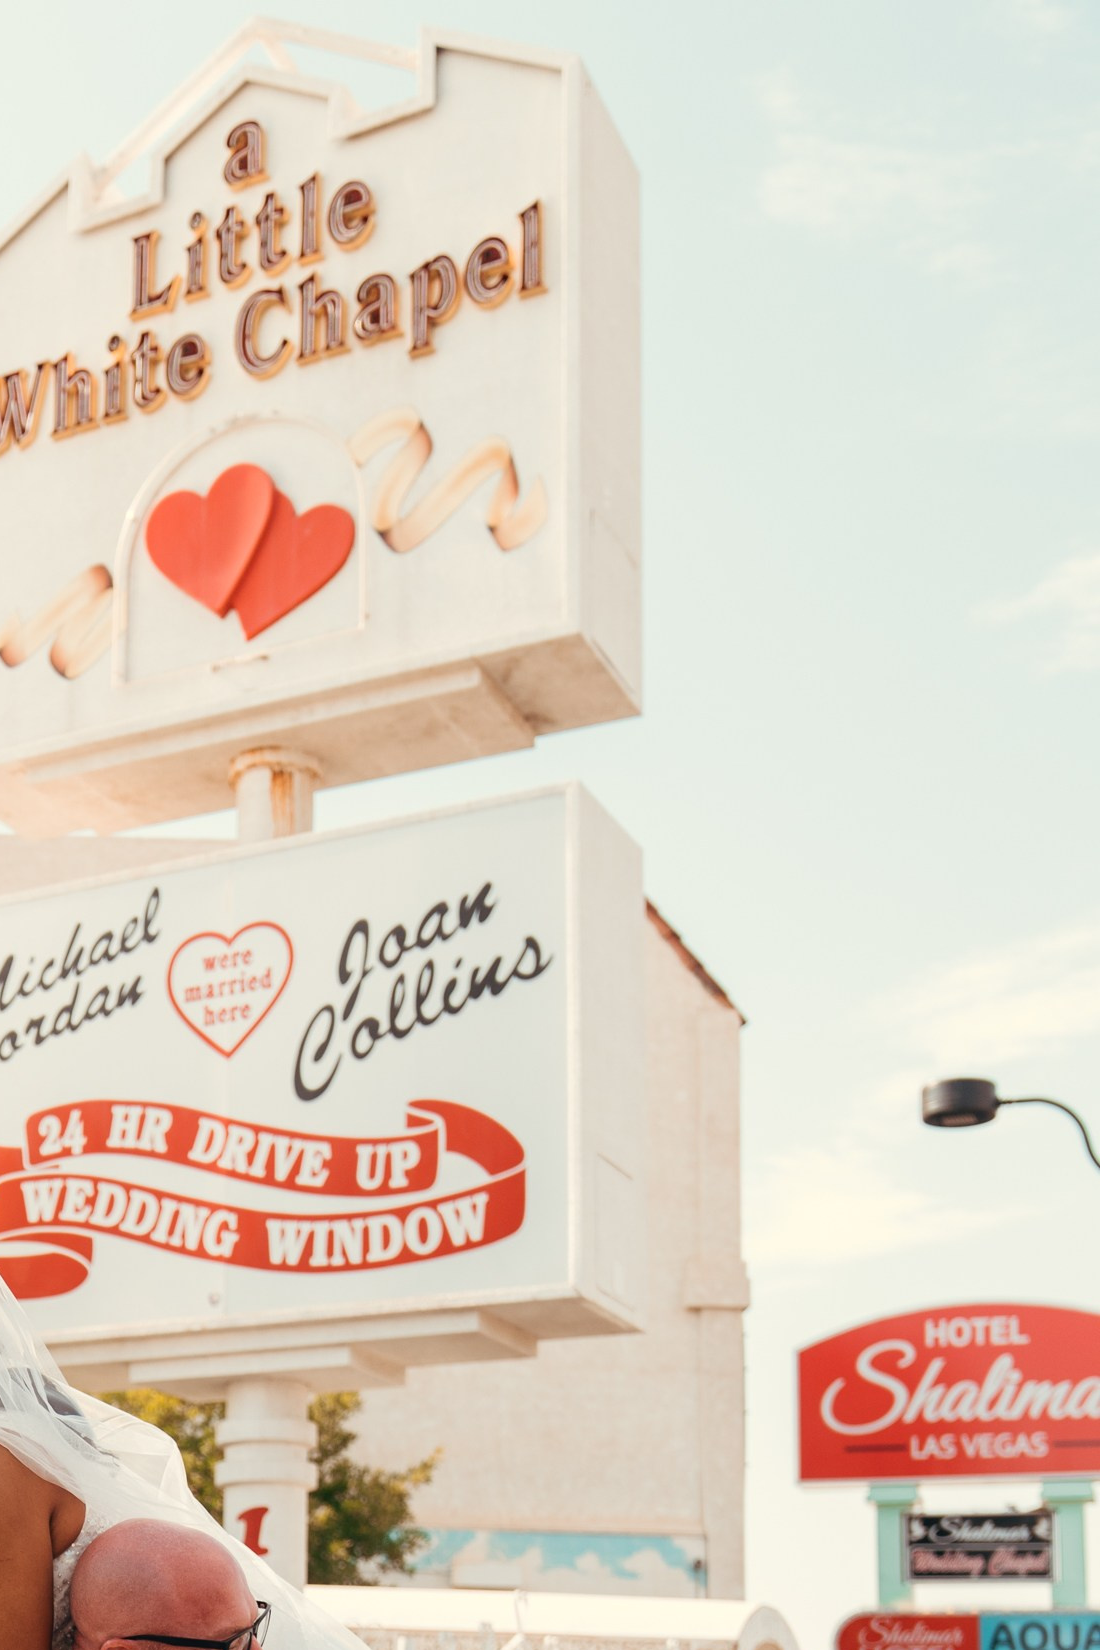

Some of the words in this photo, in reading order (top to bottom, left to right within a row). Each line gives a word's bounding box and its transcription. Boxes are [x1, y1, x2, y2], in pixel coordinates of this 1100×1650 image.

[224, 120, 269, 190] a
[130, 171, 376, 321] Little
[234, 199, 547, 380] Chapel
[185, 966, 272, 1003] married
[203, 949, 252, 972] were
[338, 881, 498, 1022] Joan
[204, 1003, 251, 1027] here
[294, 935, 555, 1102] Collins
[38, 1109, 88, 1157] 24
[107, 1105, 172, 1155] HR
[189, 1116, 332, 1189] DRIVE
[355, 1139, 423, 1191] UP
[21, 1179, 241, 1260] WEDDING
[264, 1191, 490, 1268] WINDOW
[924, 1316, 1030, 1348] HOTEL
[820, 1338, 1100, 1436] Shalima
[910, 1435, 957, 1460] LAS
[961, 1431, 1049, 1459] VEGAS
[858, 1616, 964, 1648] Shalimar
